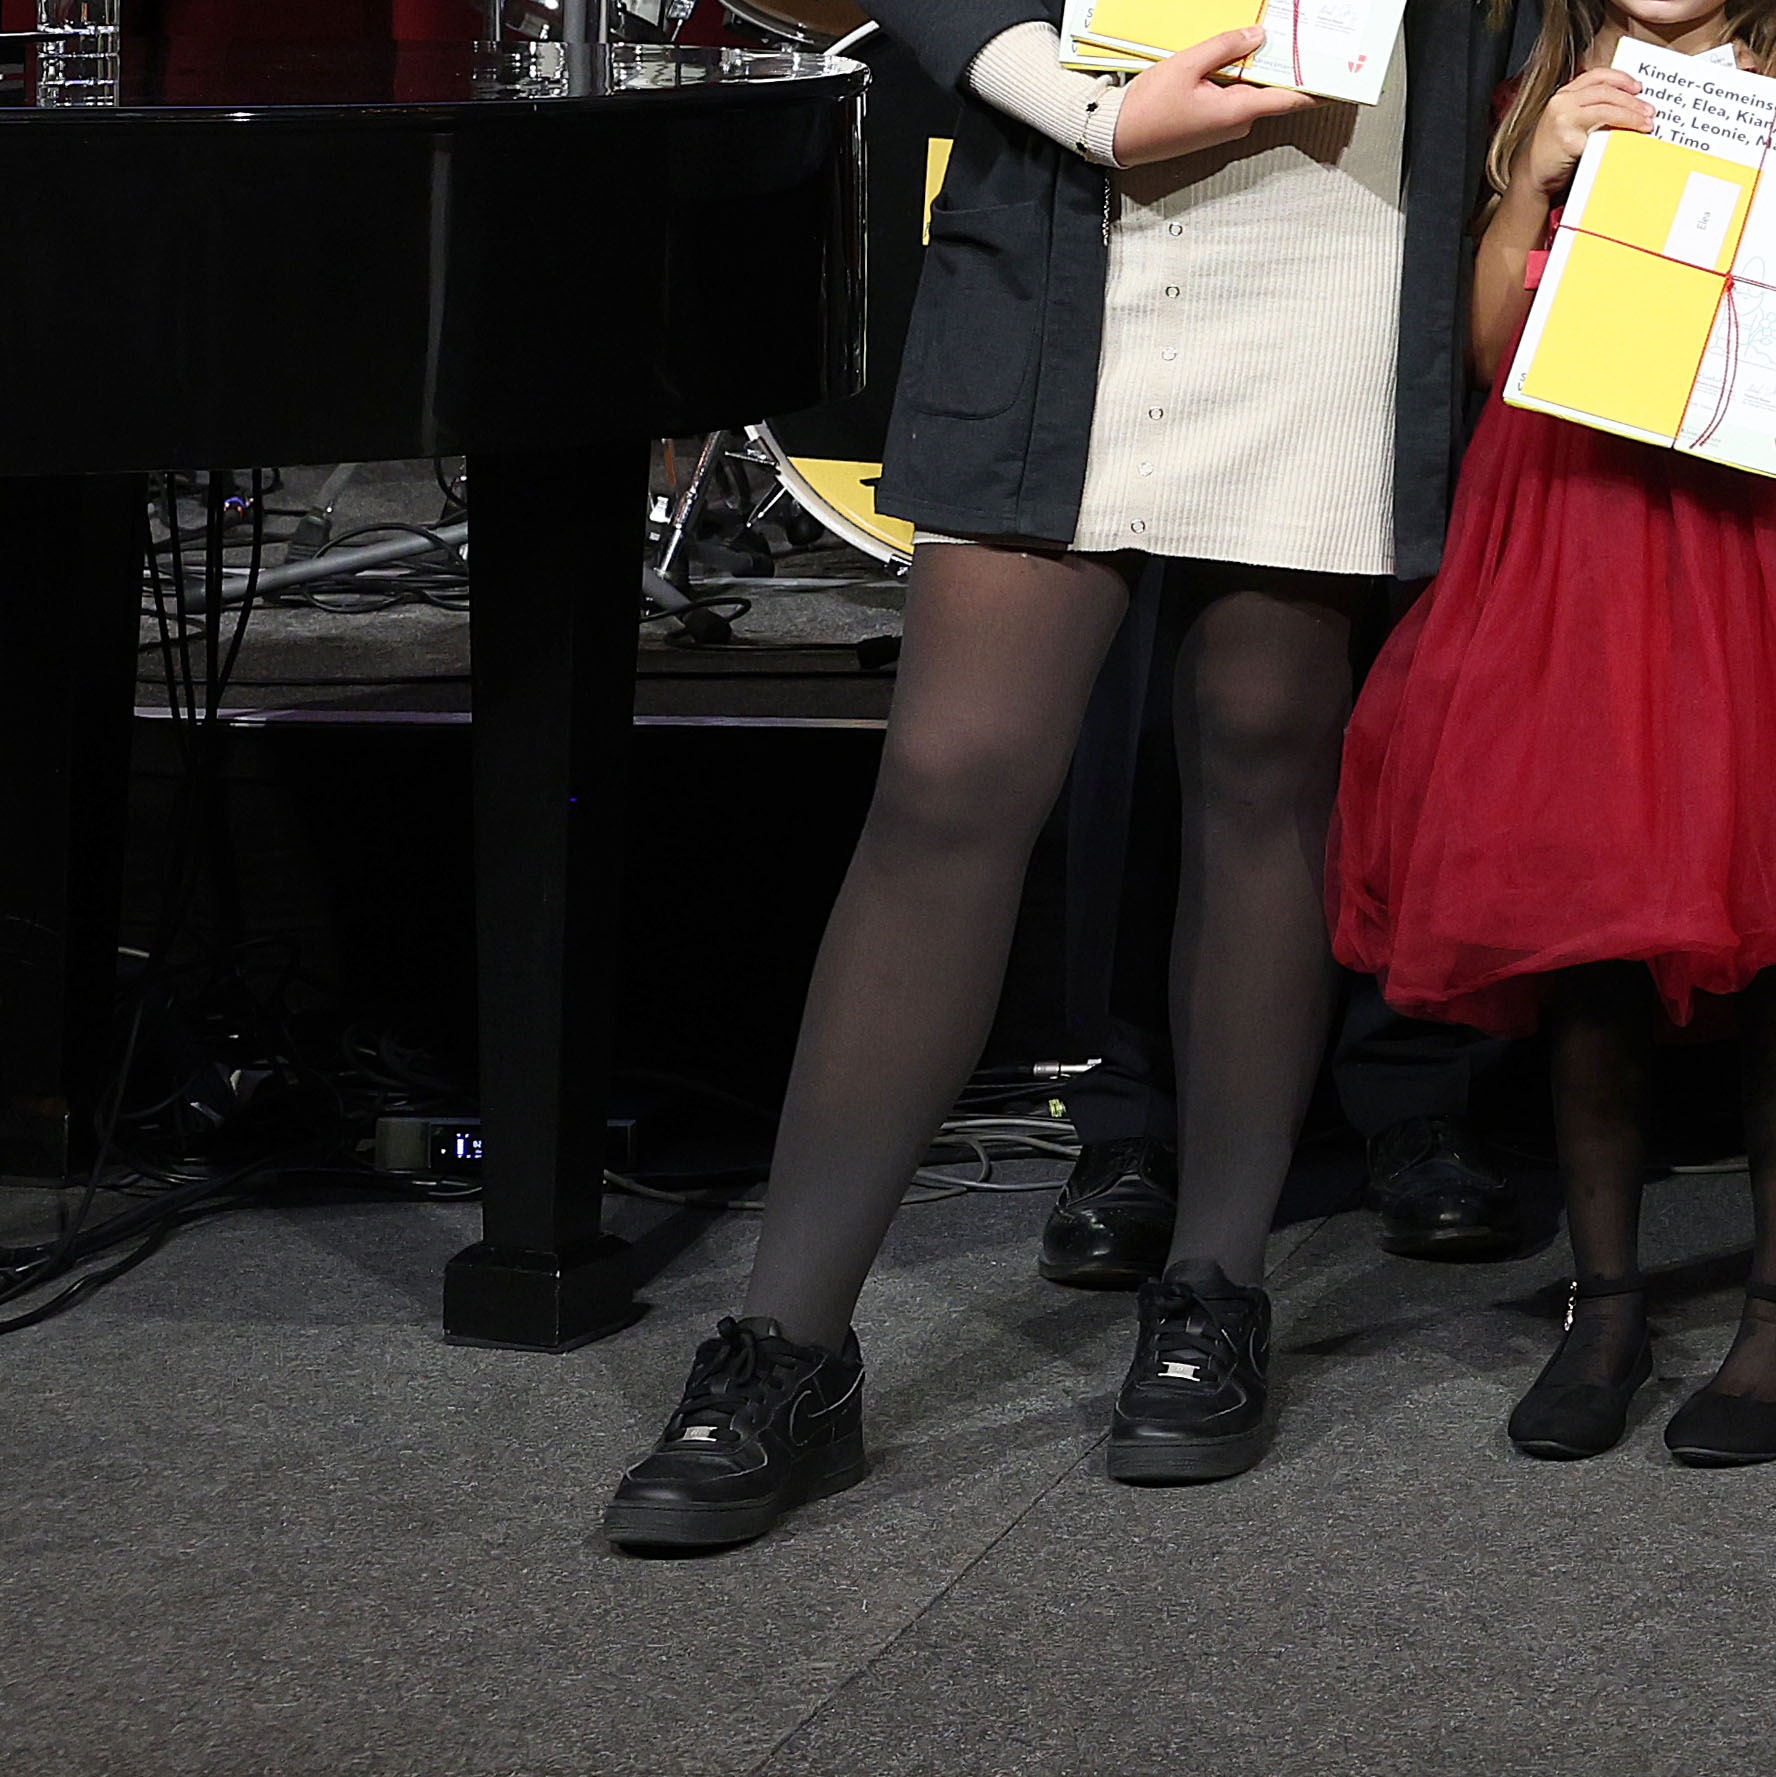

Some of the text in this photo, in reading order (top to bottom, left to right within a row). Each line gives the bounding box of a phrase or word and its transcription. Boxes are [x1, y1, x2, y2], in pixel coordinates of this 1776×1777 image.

[1639, 82, 1776, 134] ndré, Elea, Kian,
[1655, 109, 1685, 127] nie,
[1691, 116, 1750, 145] Leonie,
[1671, 129, 1710, 151] Timo
[1697, 210, 1712, 232] Elea
